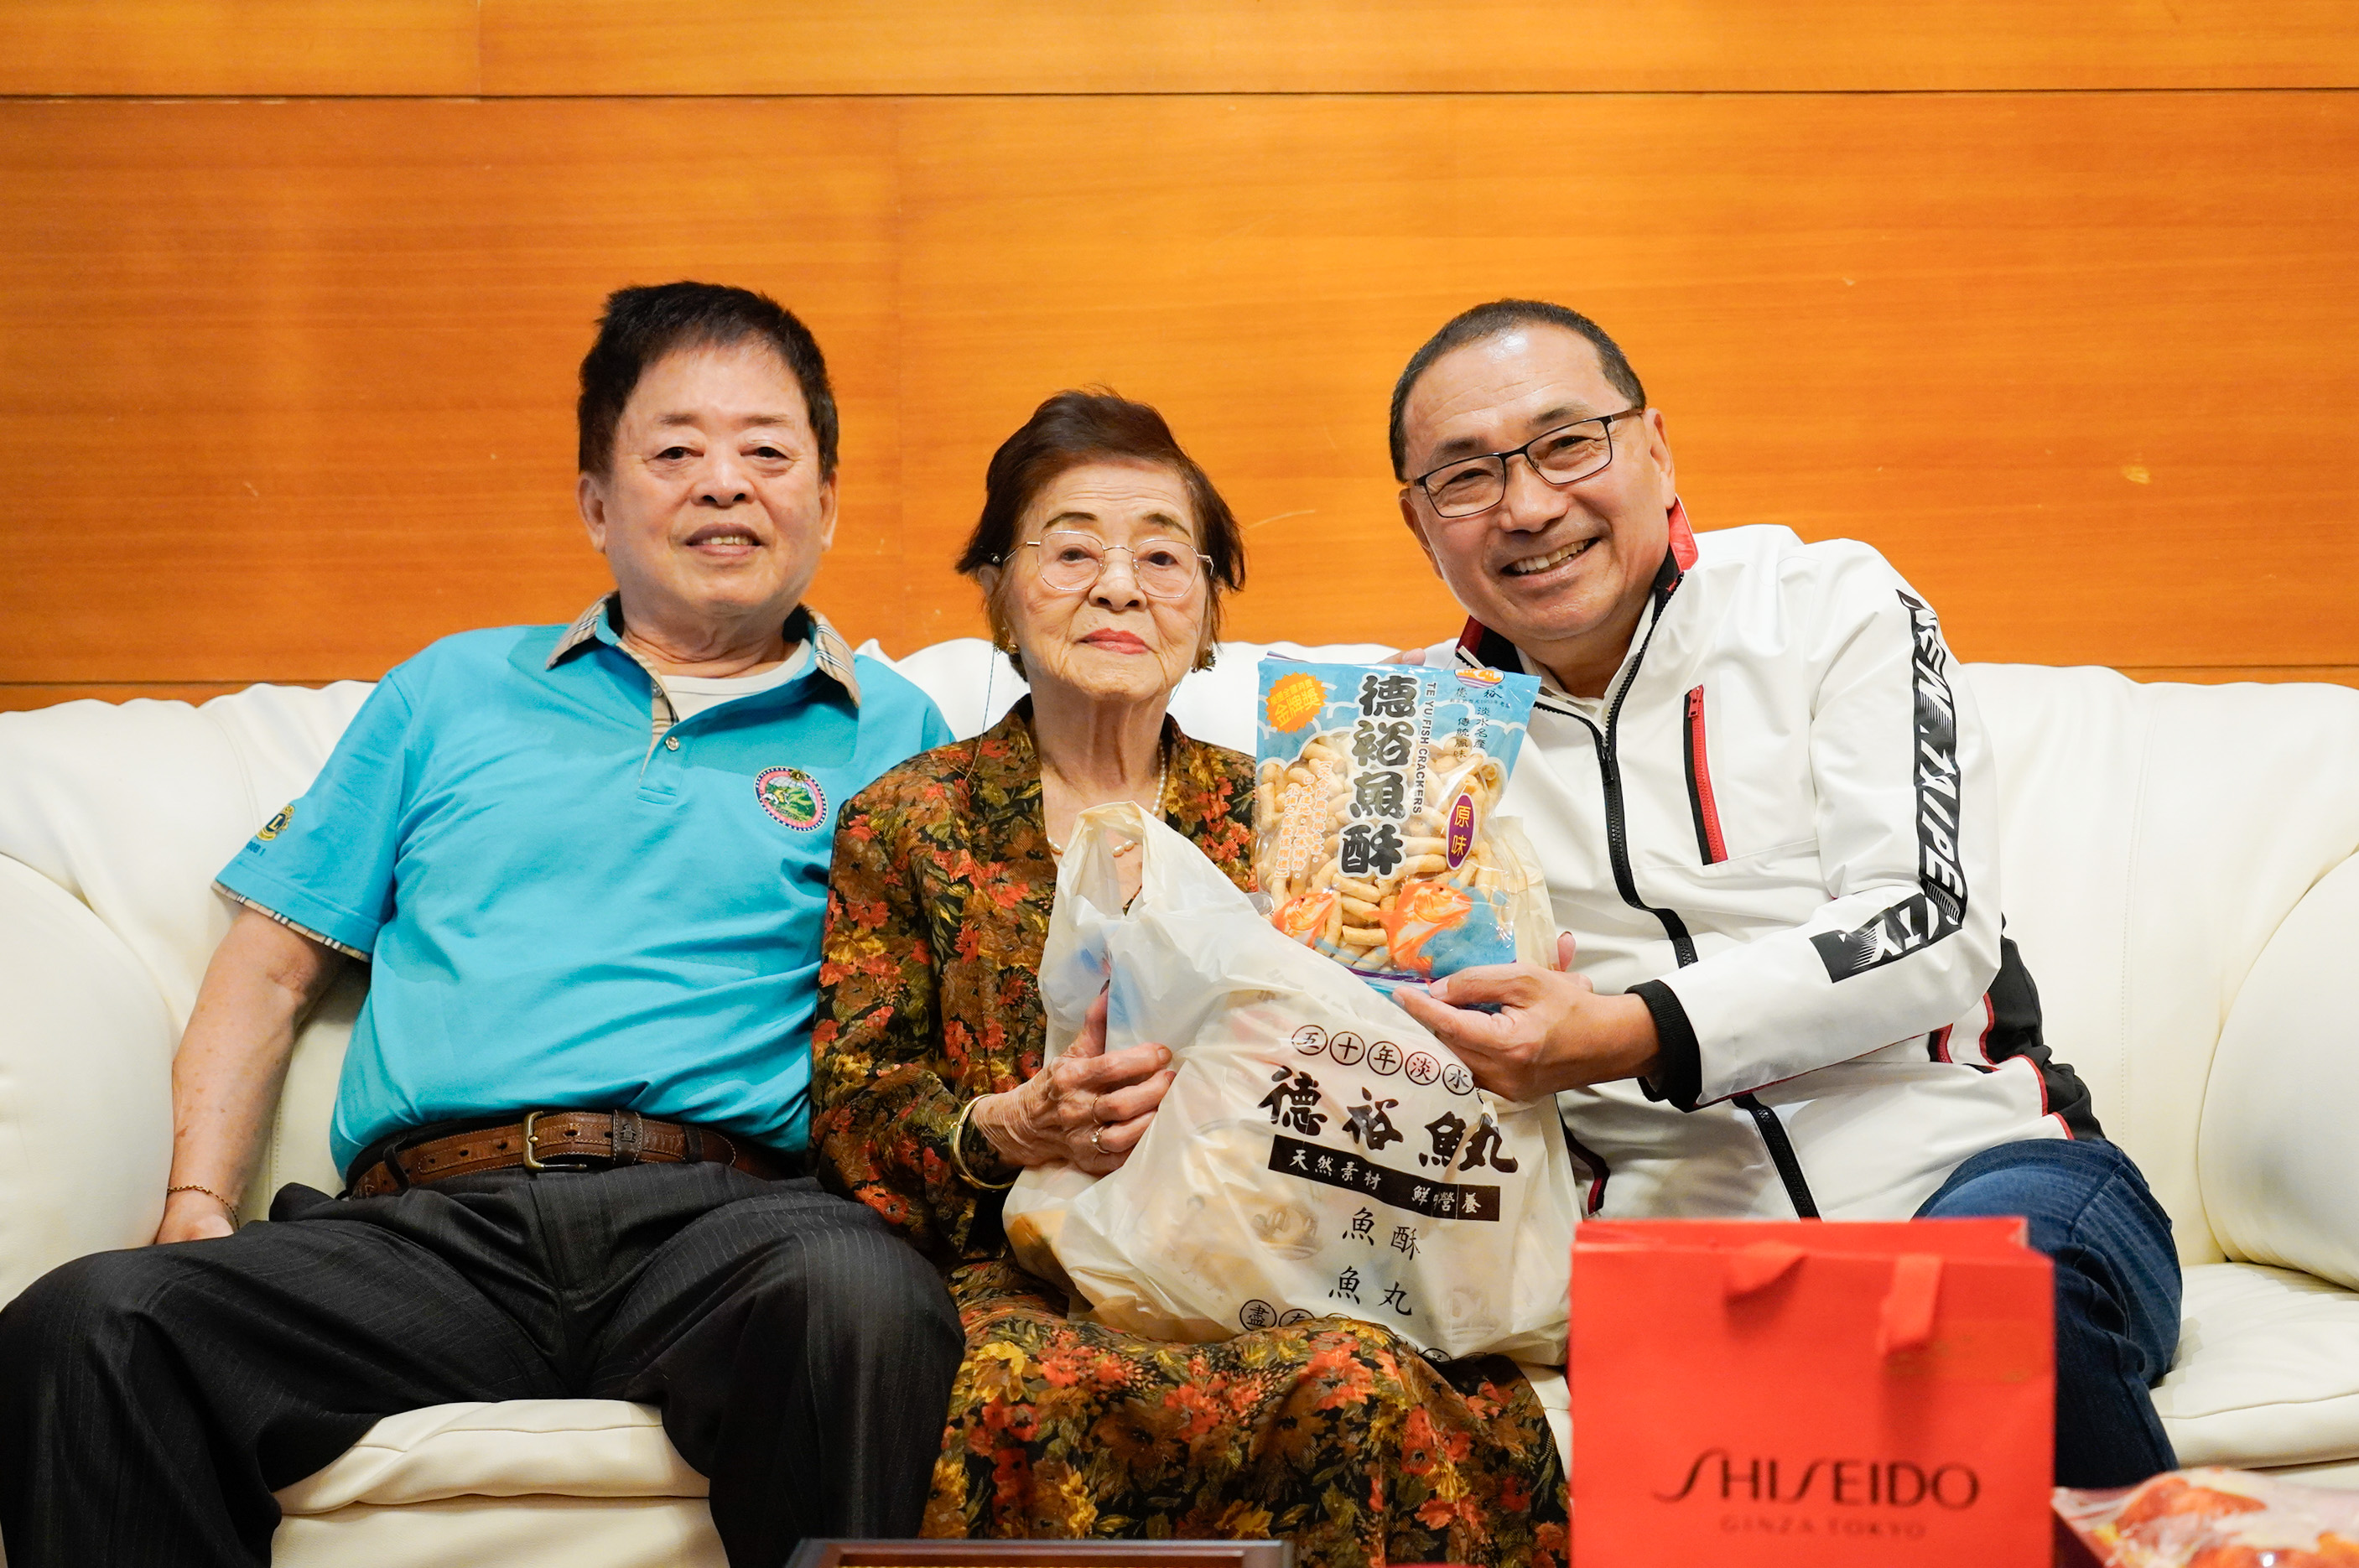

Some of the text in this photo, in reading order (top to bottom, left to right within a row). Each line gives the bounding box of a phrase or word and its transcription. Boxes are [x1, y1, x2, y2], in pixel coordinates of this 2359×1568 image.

[1275, 687, 1322, 728] 金牌獎
[1473, 706, 1491, 750] 淡水名產
[1412, 682, 1437, 814] TE YU FISH CRACKERS
[1453, 717, 1470, 759] 傳統風味
[1341, 674, 1416, 875] 德裕魚酥
[1450, 805, 1472, 858] 原味
[1257, 1065, 1519, 1174] 德裕魚丸
[1289, 1149, 1382, 1191] 天然素材
[1342, 1207, 1421, 1261] 魚酥
[1328, 1265, 1412, 1316] 魚丸
[1652, 1446, 1981, 1511] SHISEIDO
[1719, 1513, 1928, 1540] GINZA TOKYO
